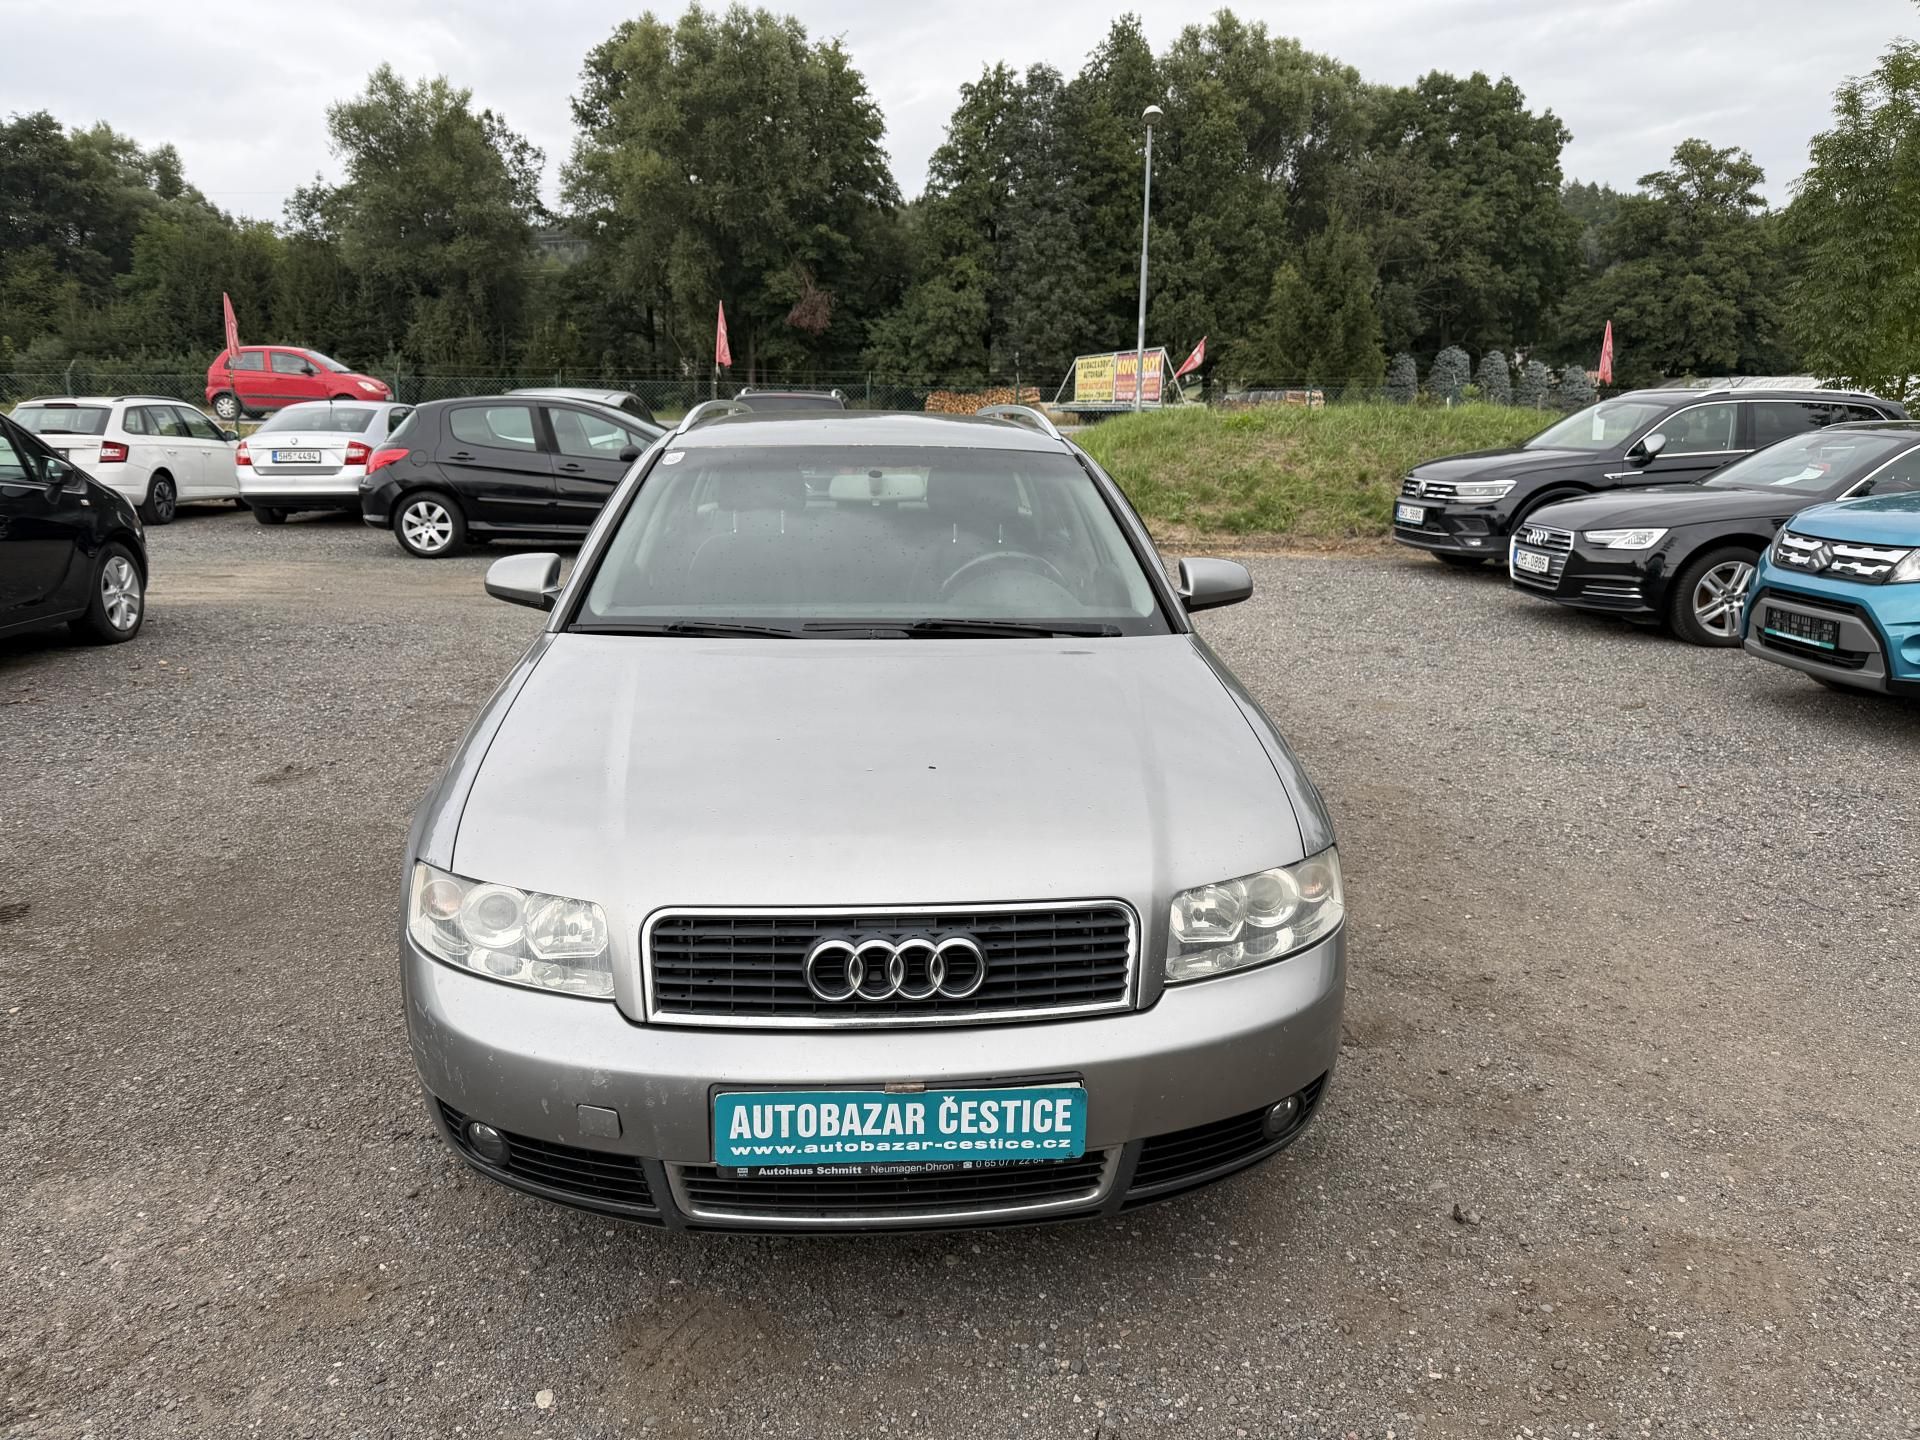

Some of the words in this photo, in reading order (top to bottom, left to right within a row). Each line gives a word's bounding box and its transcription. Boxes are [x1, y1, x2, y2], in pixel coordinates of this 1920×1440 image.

[1116, 356, 1161, 375] KOVOROT
[278, 452, 293, 460] 5H5
[297, 452, 317, 460] 4494
[729, 1102, 926, 1140] AUTOBAZAR
[938, 1096, 1073, 1135] ČESTICE
[730, 1138, 1071, 1156] www.autobazar-cestice.cz
[758, 1166, 814, 1176] Autohaus
[816, 1166, 863, 1175] Schmitt
[870, 1162, 954, 1175] Neumagen-Dhron
